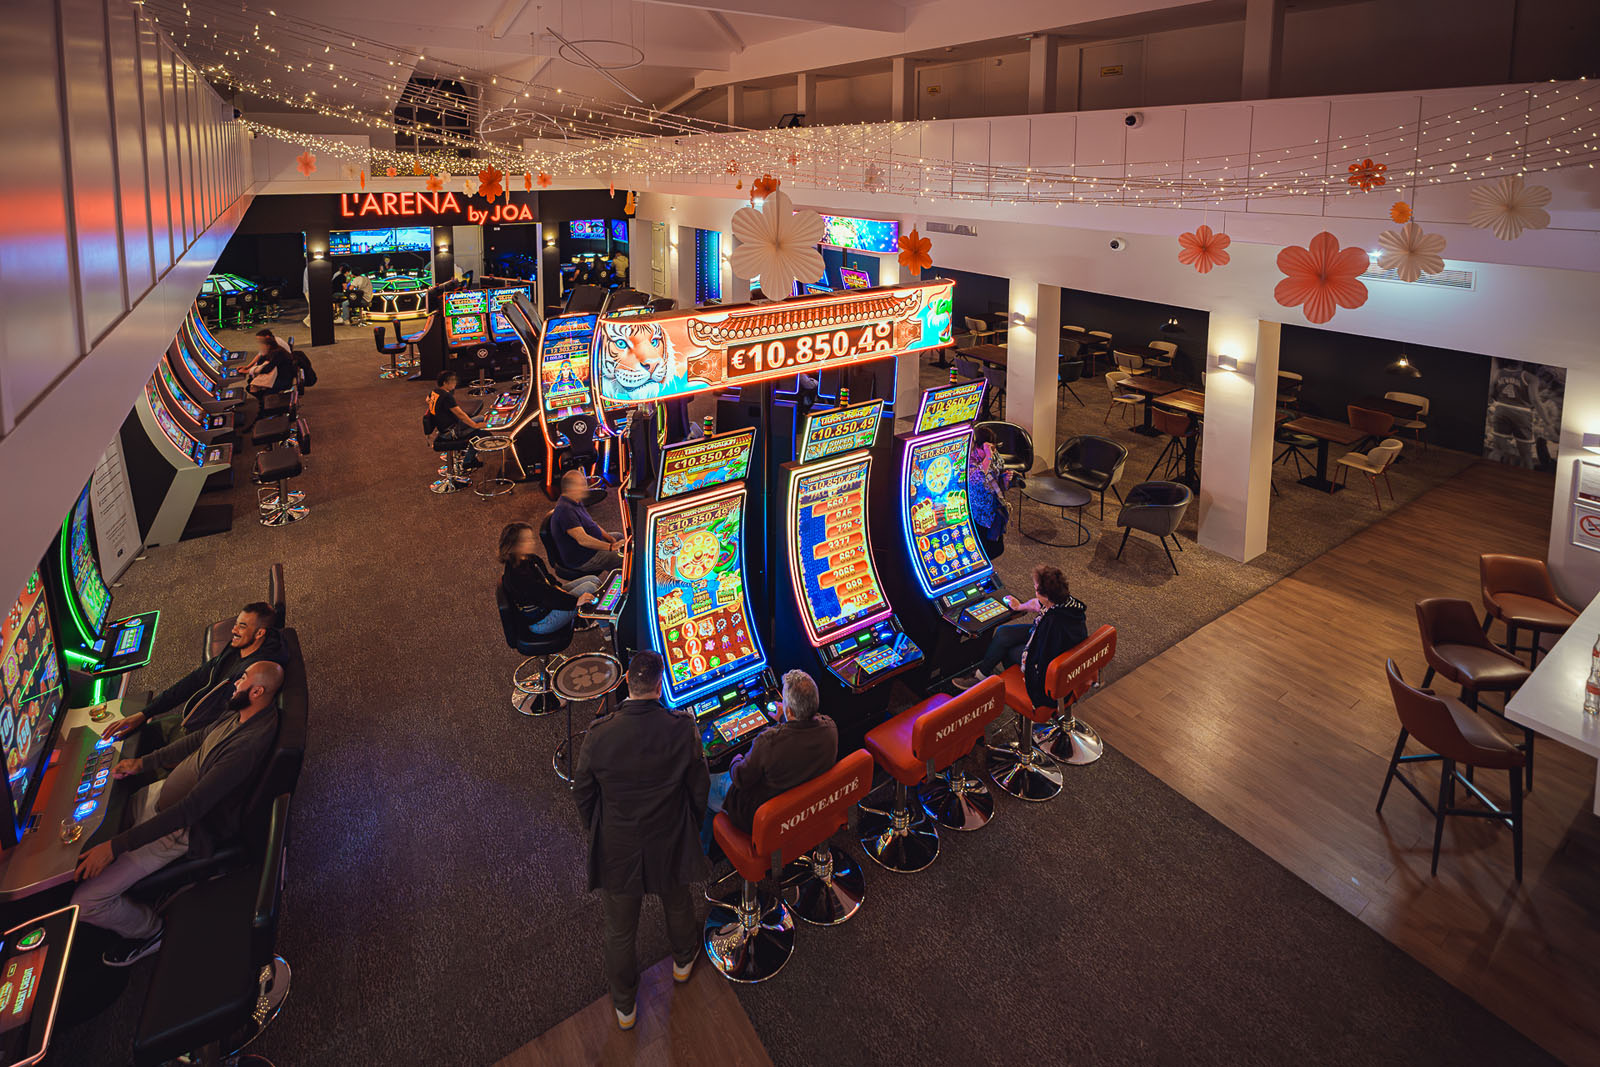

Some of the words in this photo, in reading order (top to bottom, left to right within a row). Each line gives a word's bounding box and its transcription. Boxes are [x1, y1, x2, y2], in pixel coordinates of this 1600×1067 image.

[341, 191, 461, 217] L'ARENA
[468, 205, 488, 225] by
[491, 203, 533, 221] JOA
[811, 417, 874, 440] €10.850,49
[686, 624, 694, 636] 3
[690, 640, 697, 654] 2
[693, 658, 701, 672] 9
[1066, 643, 1110, 683] NOUVEAUTÉ
[936, 695, 995, 742] NOUVEAUTÉ
[779, 776, 860, 835] NOUVEAUTÉ
